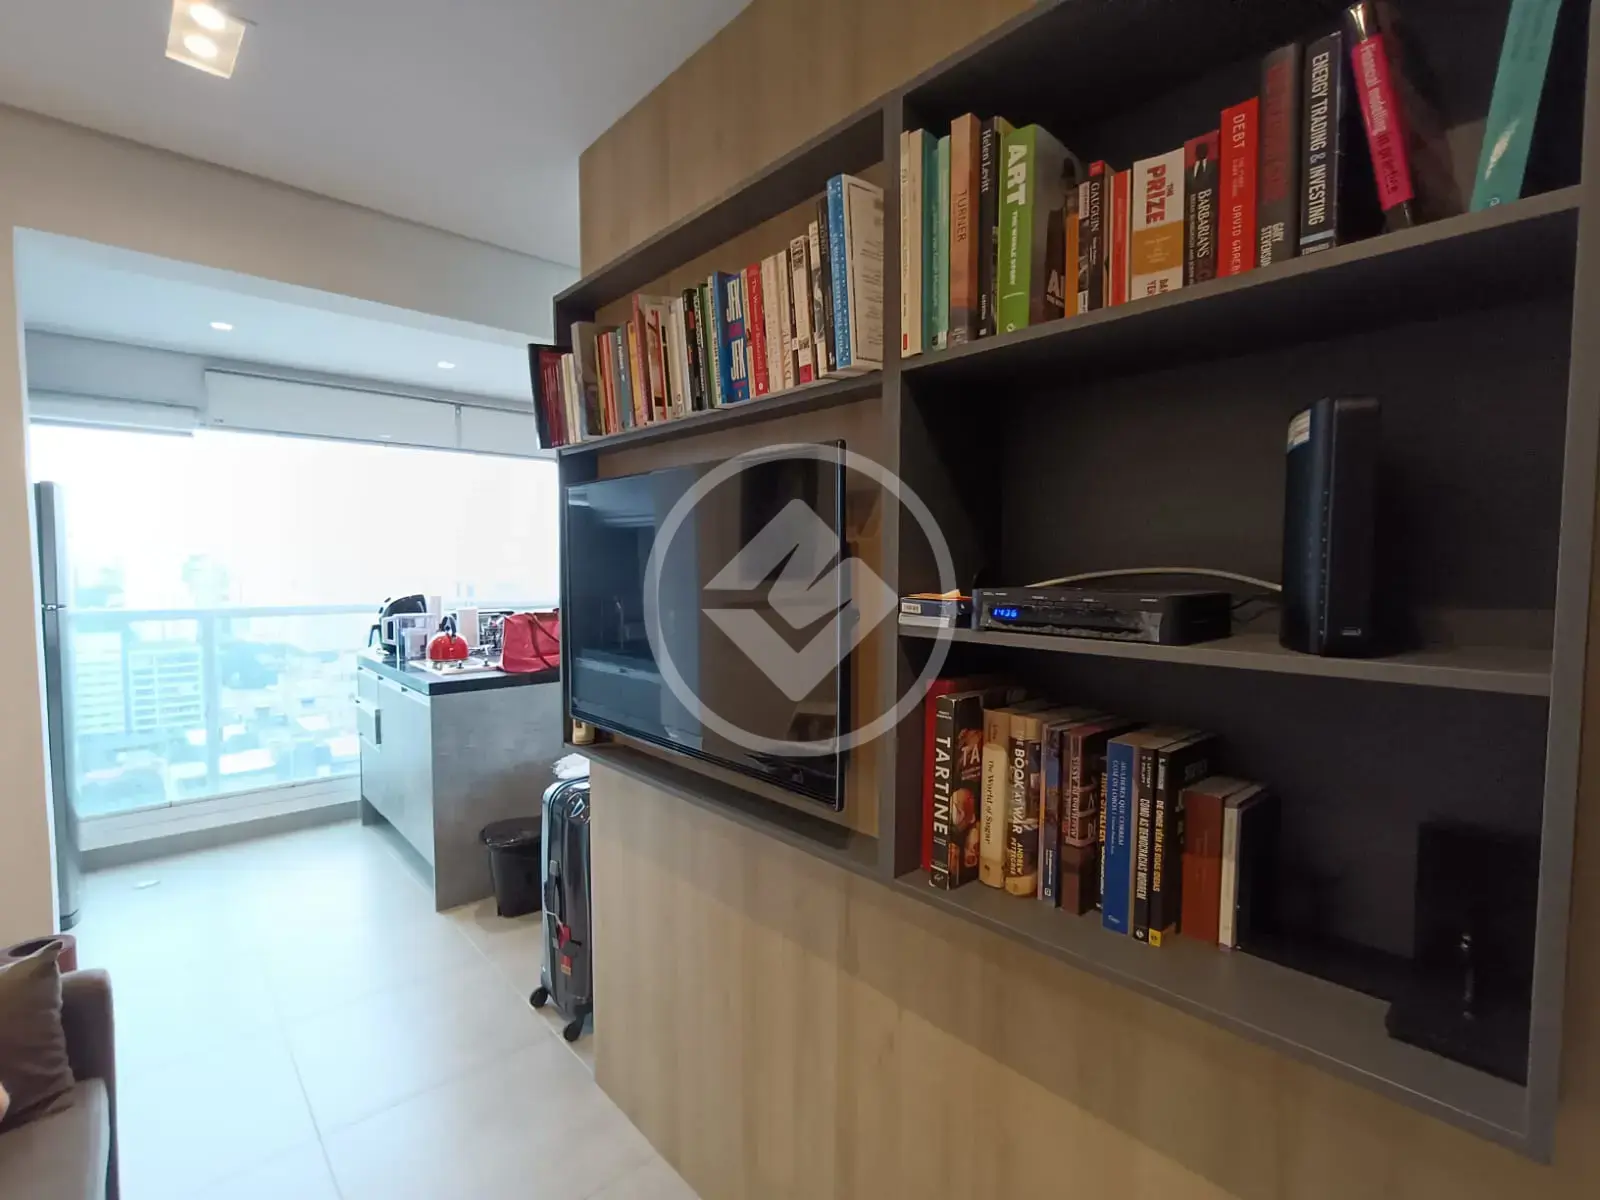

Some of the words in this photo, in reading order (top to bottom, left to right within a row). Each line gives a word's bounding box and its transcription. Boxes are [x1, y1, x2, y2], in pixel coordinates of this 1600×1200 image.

[1312, 52, 1330, 98] ENERGY
[982, 129, 991, 160] Helen
[1232, 113, 1245, 149] DEBT
[1310, 99, 1328, 151] TRADING
[1007, 144, 1027, 206] ART
[1309, 152, 1326, 164] &
[957, 189, 967, 242] TURNER
[1090, 182, 1100, 232] GAUGUIN
[1146, 164, 1166, 224] PRIZE
[1308, 164, 1326, 225] INVESTING
[1197, 188, 1212, 258] BARBARIANS
[1231, 205, 1243, 237] DAVID
[726, 277, 742, 323] JFK
[730, 338, 746, 381] JFK
[933, 737, 951, 835] TARTINE
[985, 775, 995, 804] World
[1013, 748, 1025, 790] BOOK
[1012, 804, 1025, 835] WAR
[1139, 798, 1150, 817] COMO
[983, 815, 993, 845] Sugar
[1137, 828, 1149, 870] DEMOCRACIAS
